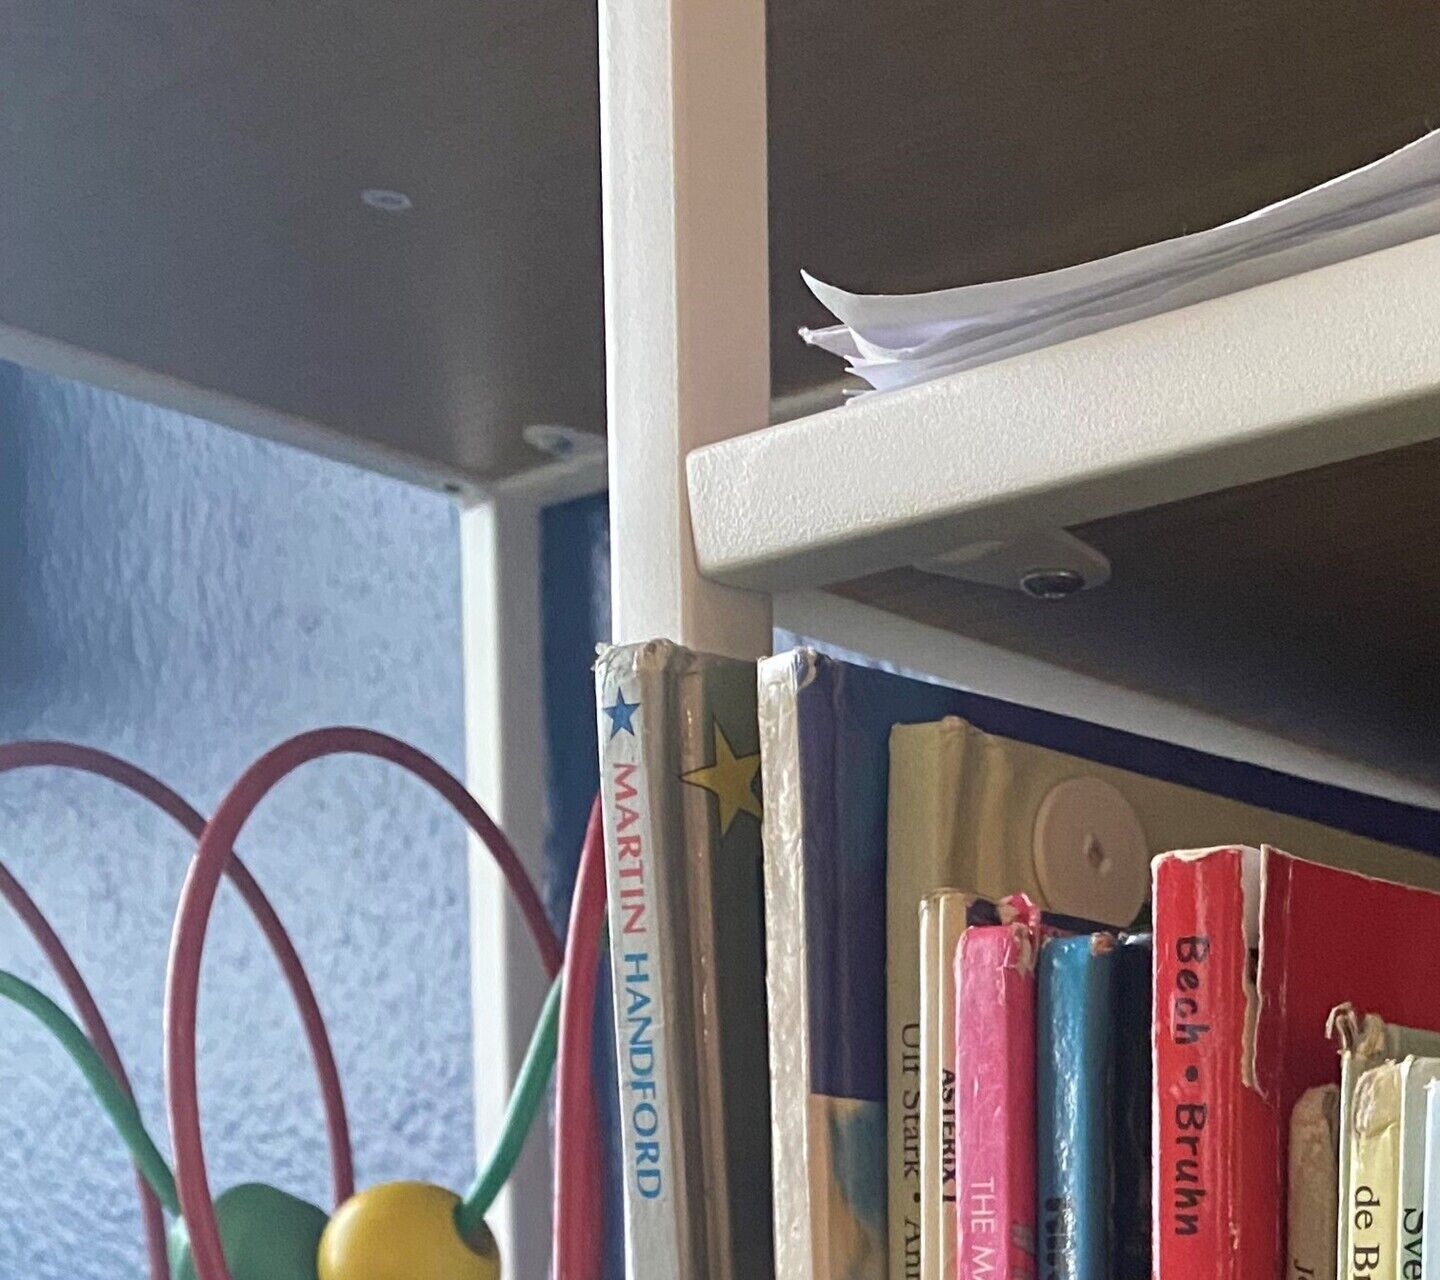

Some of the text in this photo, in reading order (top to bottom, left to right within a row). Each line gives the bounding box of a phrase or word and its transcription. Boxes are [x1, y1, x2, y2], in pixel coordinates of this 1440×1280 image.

[613, 761, 663, 1199] MARTIN HANDFORD
[1175, 935, 1212, 1237] Bech Bruhn
[903, 1090, 922, 1179] Stark
[971, 1177, 996, 1234] THE
[1354, 1185, 1381, 1229] de
